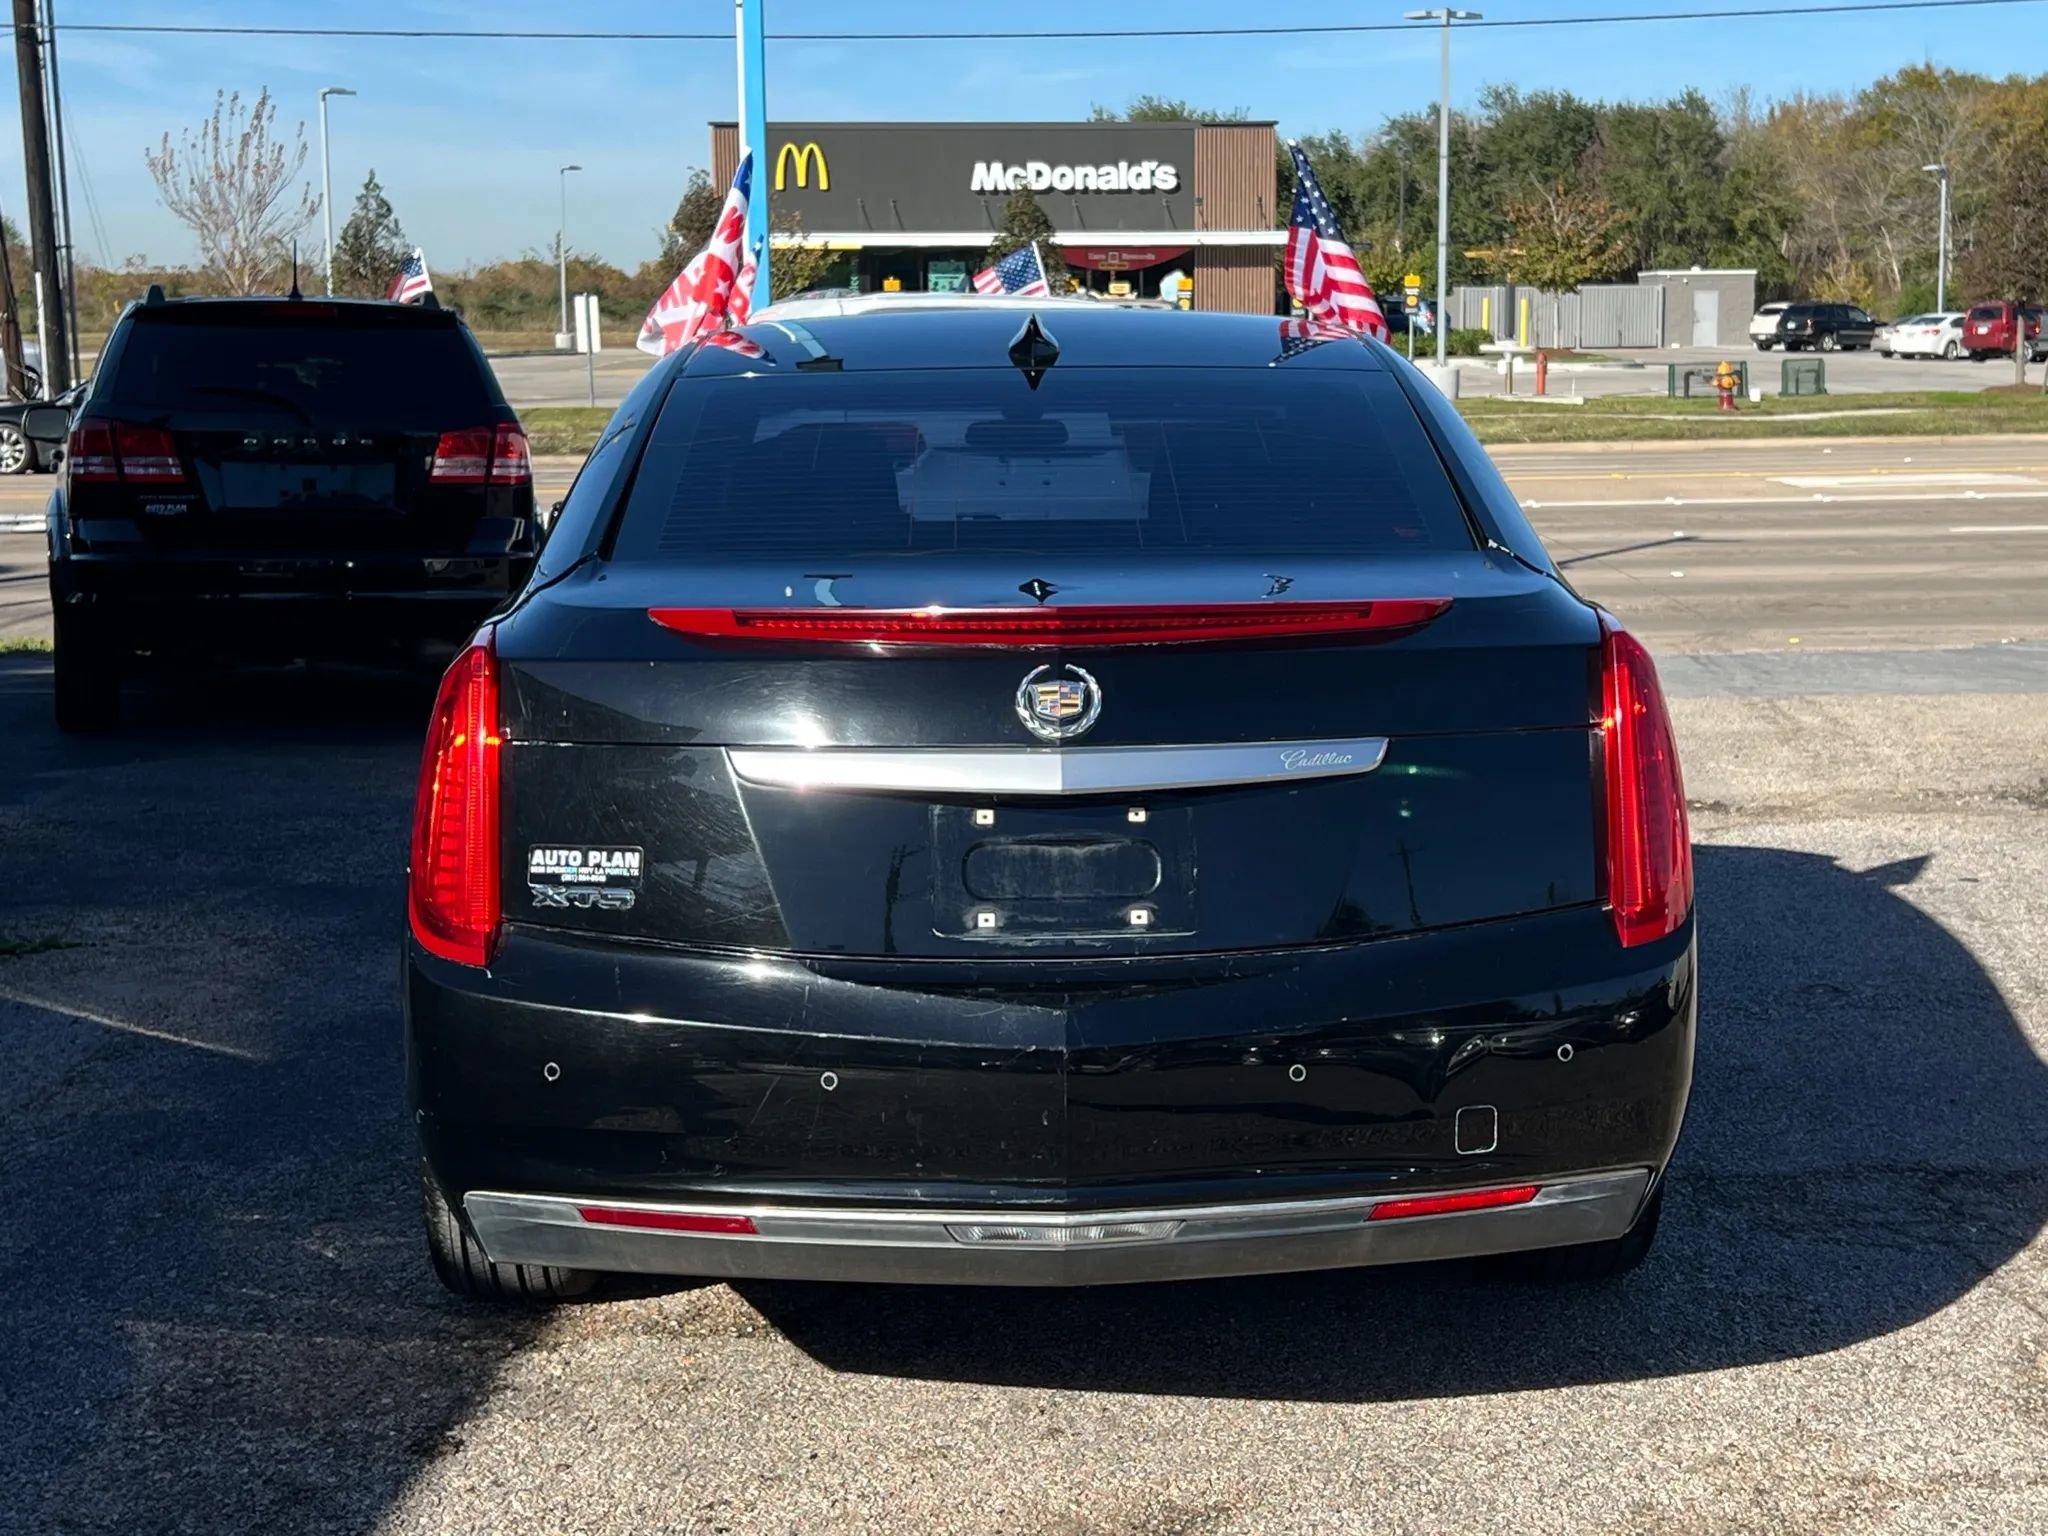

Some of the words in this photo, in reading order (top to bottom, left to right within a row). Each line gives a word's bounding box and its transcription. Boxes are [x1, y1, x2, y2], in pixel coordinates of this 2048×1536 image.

[970, 161, 1178, 191] McDonald's
[1280, 749, 1352, 770] Cadillac
[531, 849, 582, 867] AUTO
[588, 850, 640, 868] PLAN
[630, 868, 640, 876] TX
